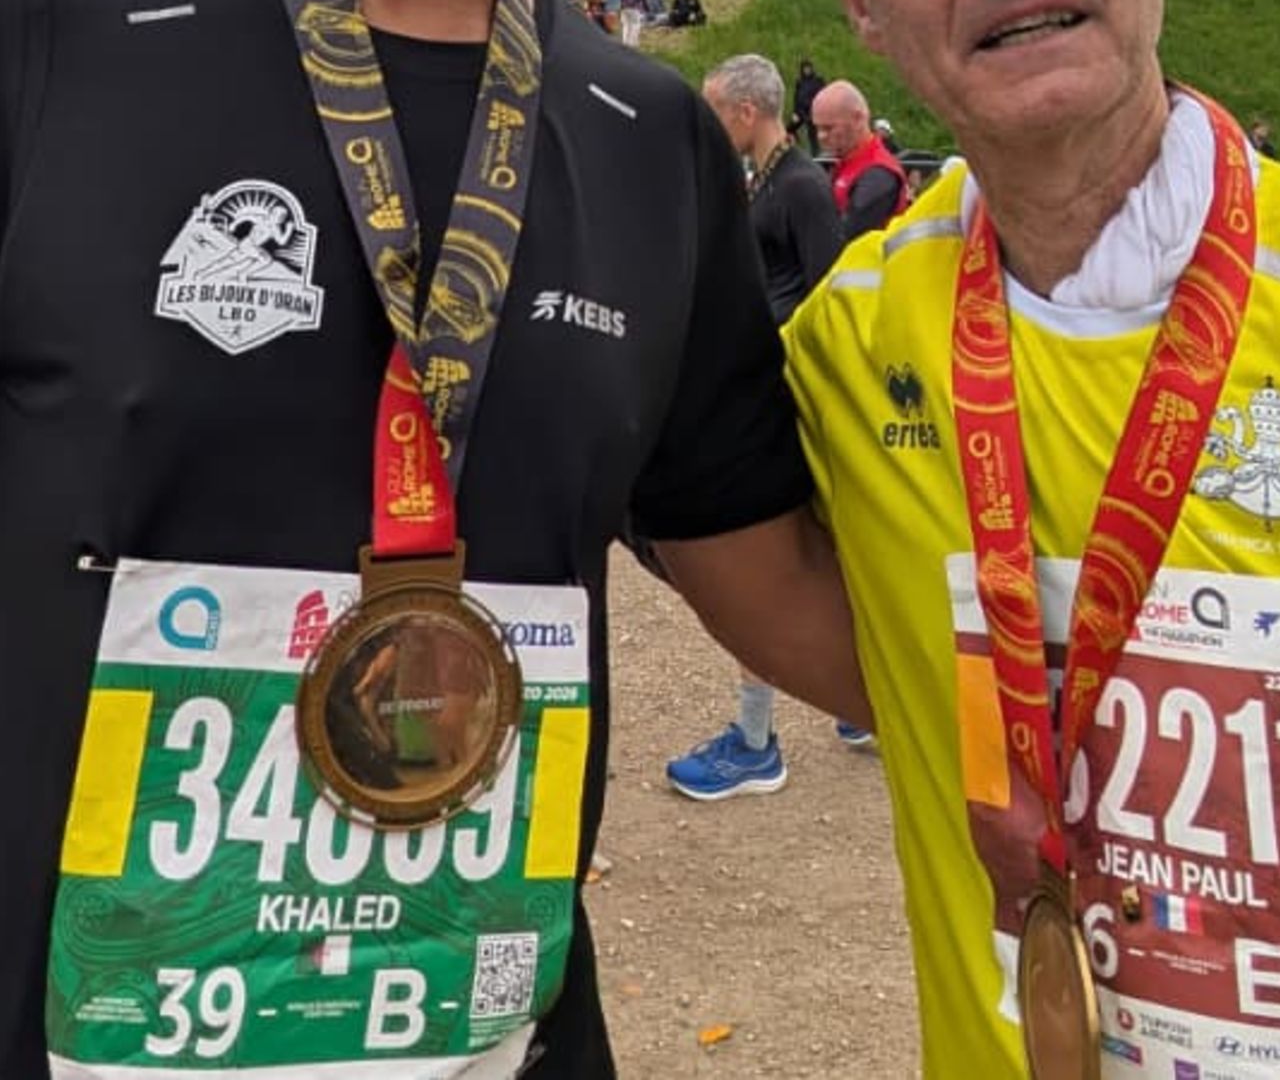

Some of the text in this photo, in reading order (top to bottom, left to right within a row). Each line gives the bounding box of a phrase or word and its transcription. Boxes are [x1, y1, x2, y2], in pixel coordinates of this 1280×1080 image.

[167, 284, 313, 316] LES BIJOUX D'ORAN
[563, 293, 626, 338] KEBS
[1140, 602, 1189, 624] OME
[503, 622, 576, 647] oma
[1097, 842, 1268, 908] JEAN PAUL
[257, 895, 401, 933] KHALED
[144, 966, 247, 1057] 39
[363, 968, 427, 1050] B
